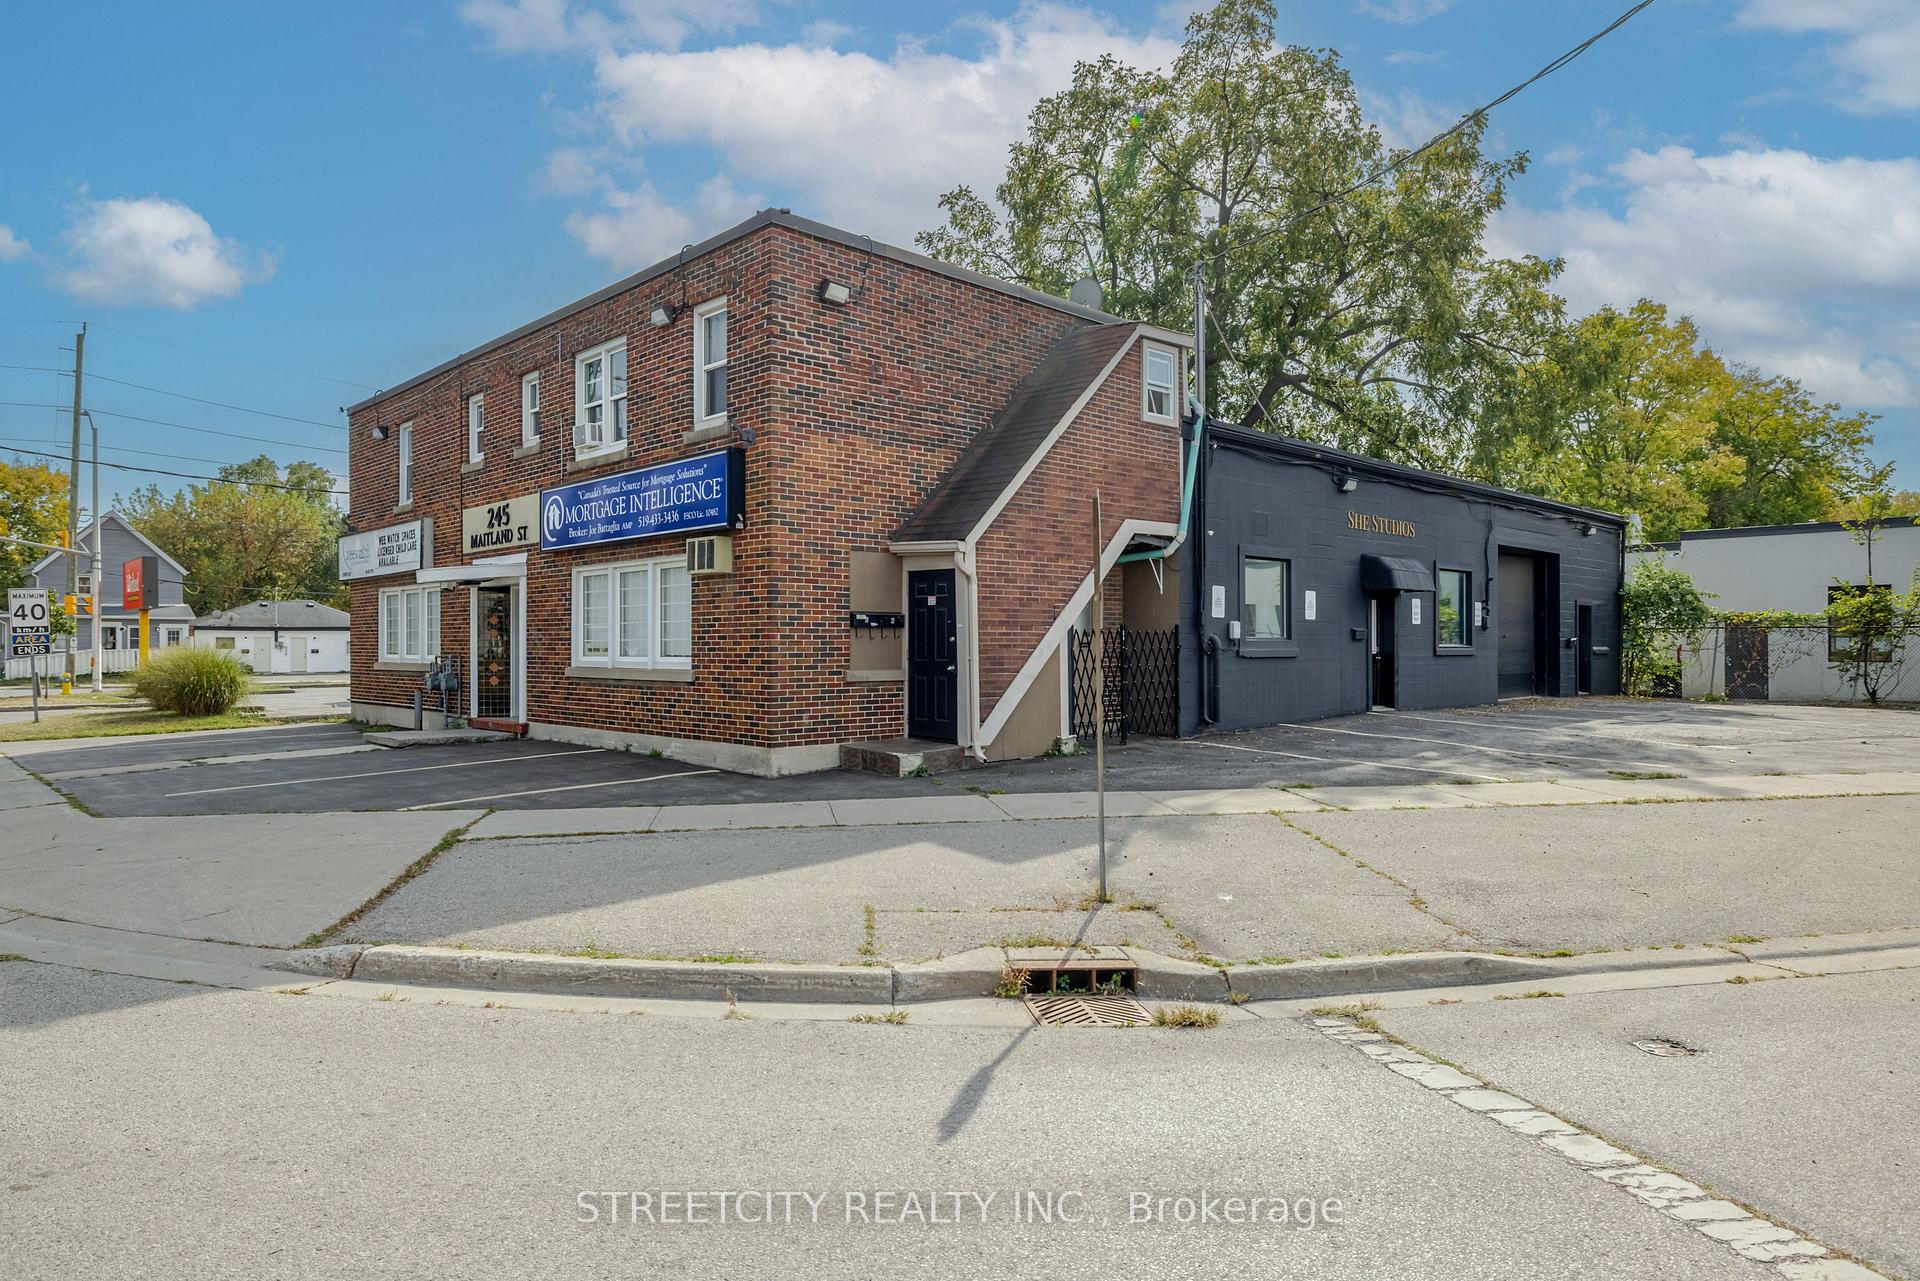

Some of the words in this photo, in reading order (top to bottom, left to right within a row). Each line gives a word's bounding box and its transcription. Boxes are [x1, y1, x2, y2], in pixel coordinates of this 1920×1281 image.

[602, 482, 620, 496] Trusted
[621, 480, 640, 491] Source
[641, 477, 650, 490] for
[650, 474, 676, 486] Mortgage
[486, 503, 511, 529] 245
[565, 496, 627, 524] MORTGAGE
[588, 525, 597, 537] Joe
[621, 521, 633, 530] AMP
[638, 509, 680, 528] 519-433-3436
[1348, 510, 1370, 531] SHE
[1372, 514, 1416, 538] STUDIOS
[378, 535, 387, 545] WEE
[387, 532, 400, 543] WATCH
[401, 529, 416, 541] SPACES
[470, 528, 514, 549] MAITLAND
[378, 545, 395, 557] LICENSED
[395, 543, 407, 554] CHILD
[407, 541, 417, 551] CARE
[378, 555, 399, 567] AVAILABLE
[13, 603, 46, 621] 40
[15, 635, 47, 644] AREA
[17, 646, 46, 655] ENDS
